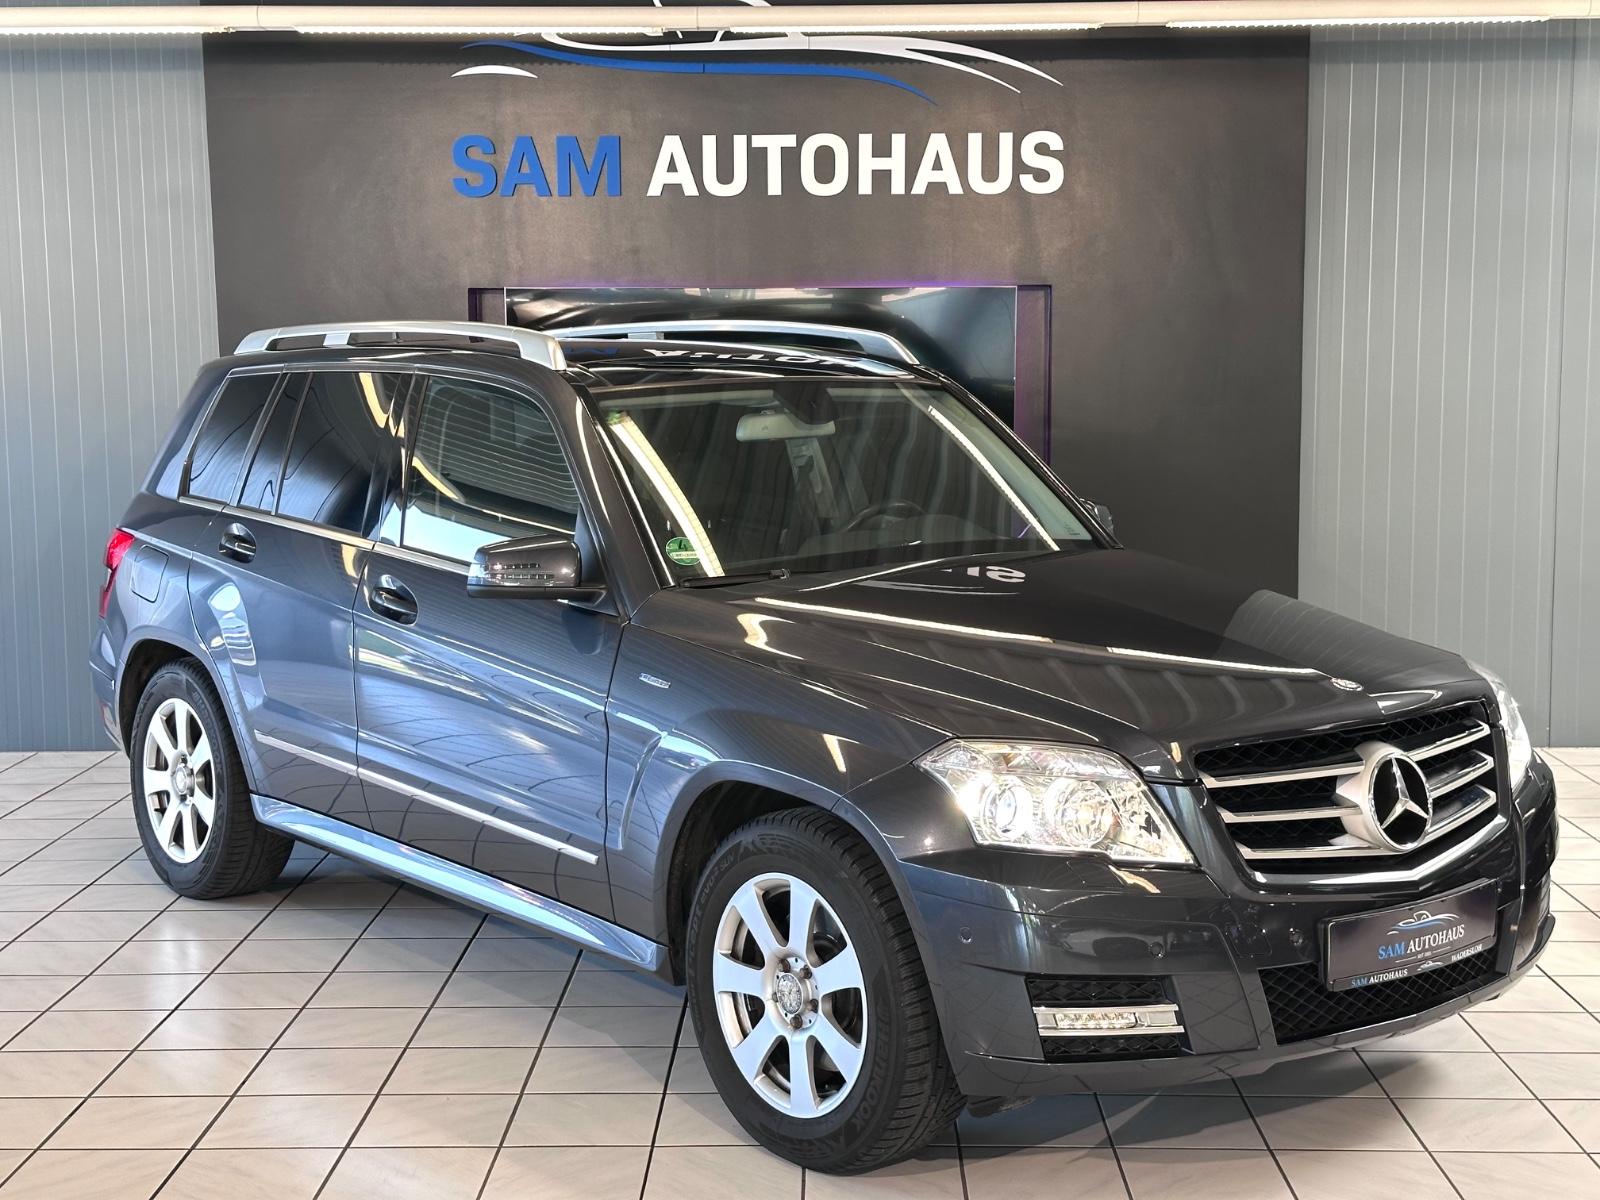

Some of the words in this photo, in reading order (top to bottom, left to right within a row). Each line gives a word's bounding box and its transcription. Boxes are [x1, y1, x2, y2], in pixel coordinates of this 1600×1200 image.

[452, 135, 622, 197] SAM
[647, 130, 1066, 197] AUTOHAUS
[677, 539, 689, 552] 4
[1378, 942, 1405, 960] SAM
[1407, 924, 1465, 953] AUTOHAUS
[1351, 976, 1369, 988] SAM
[1368, 968, 1408, 984] AUTOHAUS
